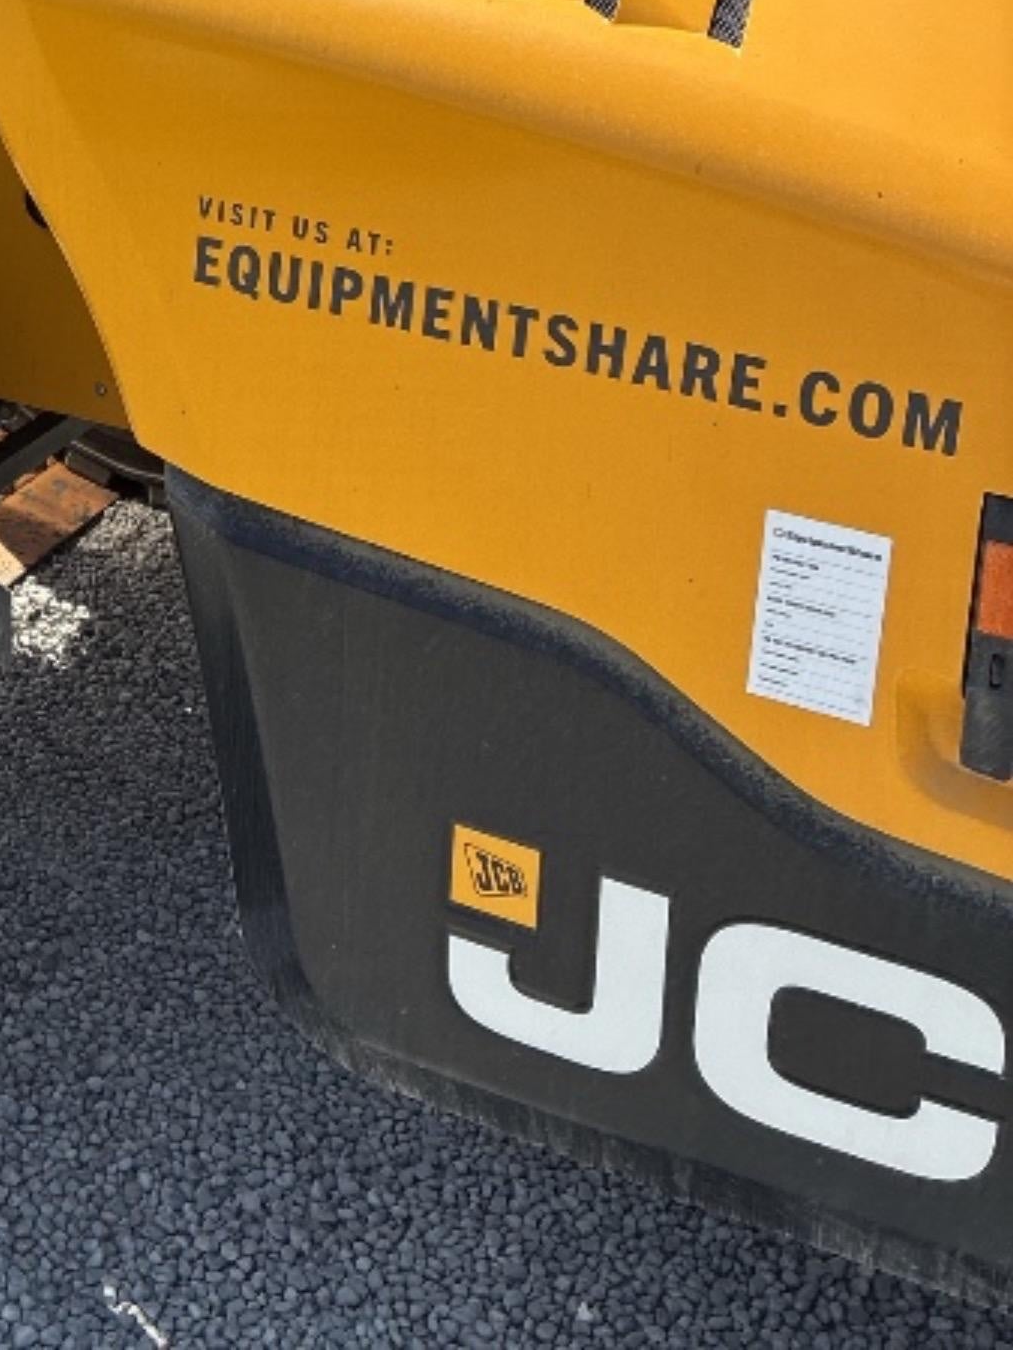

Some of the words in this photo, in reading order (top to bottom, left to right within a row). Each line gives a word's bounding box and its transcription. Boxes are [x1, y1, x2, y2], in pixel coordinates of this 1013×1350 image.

[198, 196, 276, 232] VISIT
[292, 215, 329, 245] US
[346, 227, 394, 255] AT:
[193, 237, 963, 456] EQUIPMENTSHARE.COM
[475, 851, 522, 895] JCB
[448, 875, 1006, 1182] JC
